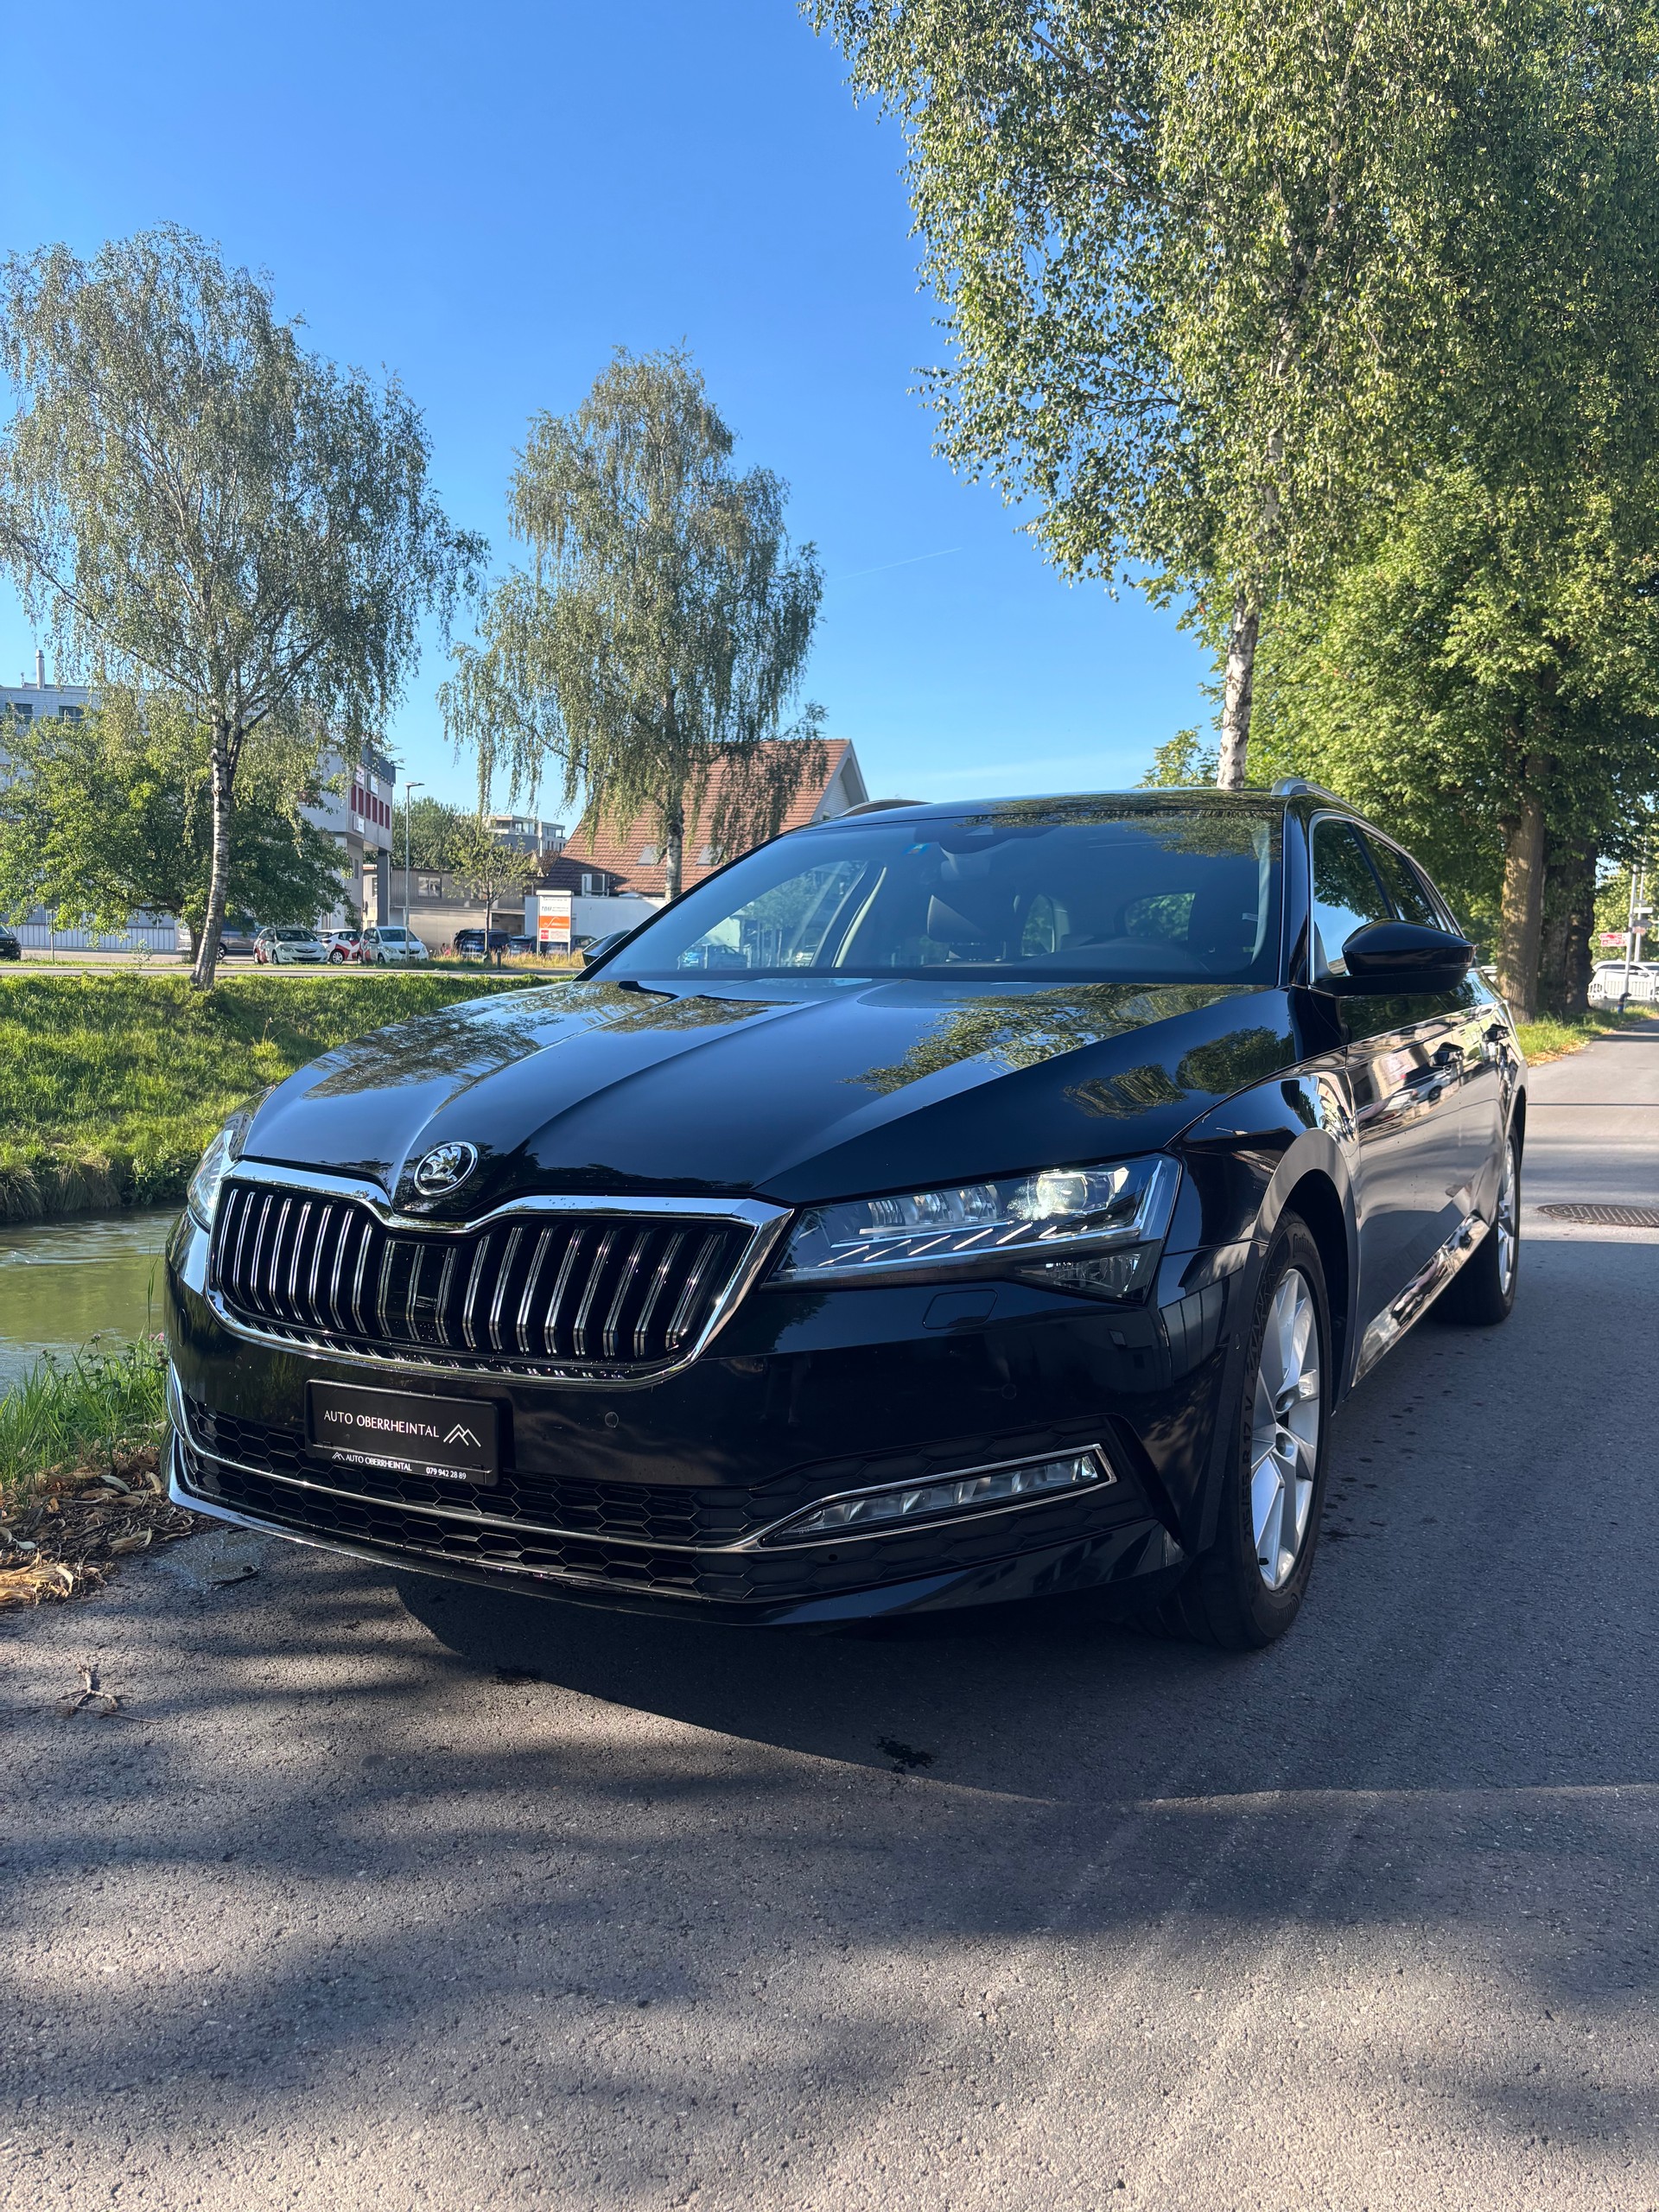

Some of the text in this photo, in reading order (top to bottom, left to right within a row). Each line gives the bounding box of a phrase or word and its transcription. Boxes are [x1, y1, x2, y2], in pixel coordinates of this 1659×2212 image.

[324, 1410, 440, 1438] AUTO OBERRHEINTAL
[1243, 1421, 1251, 1444] 17
[346, 1454, 467, 1480] AUTO OBERRHEINTAL 079 942 28 89
[1242, 1450, 1250, 1465] R
